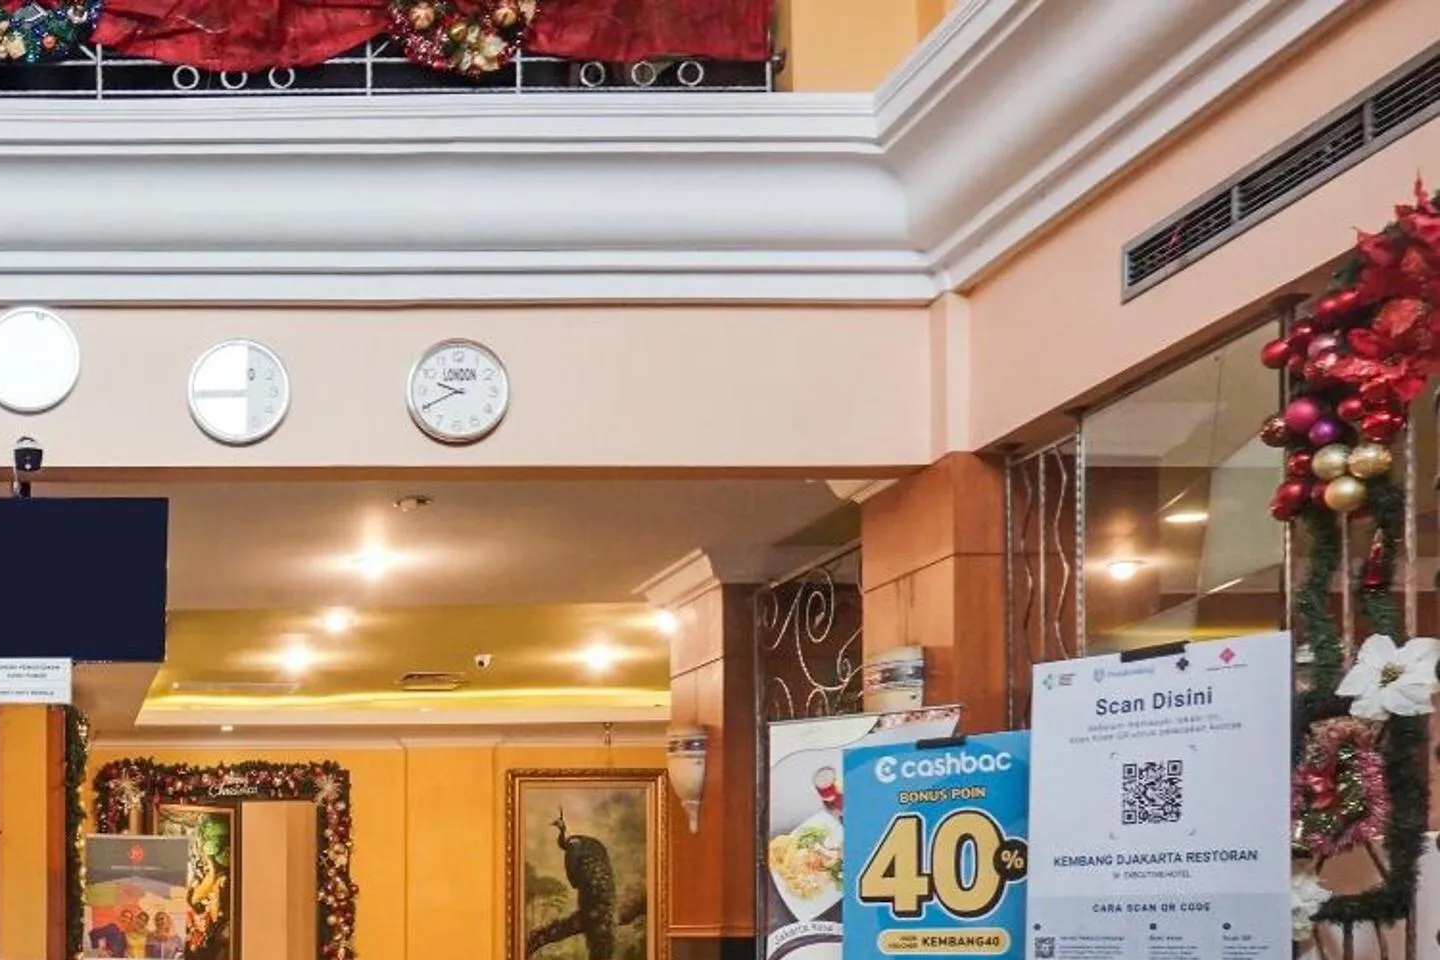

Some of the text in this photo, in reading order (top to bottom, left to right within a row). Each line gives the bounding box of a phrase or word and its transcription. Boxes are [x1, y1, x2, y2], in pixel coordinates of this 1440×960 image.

[443, 367, 478, 382] LONDON
[1095, 686, 1213, 716] Scan Disini
[901, 751, 1012, 778] cashbac
[899, 786, 987, 804] BONUS POIN
[1053, 849, 1259, 868] KEMBANG DJAKARTA RESTORAN
[1092, 902, 1212, 914] CARA SCAN QR CODE
[921, 935, 1001, 948] KEMBANG40
